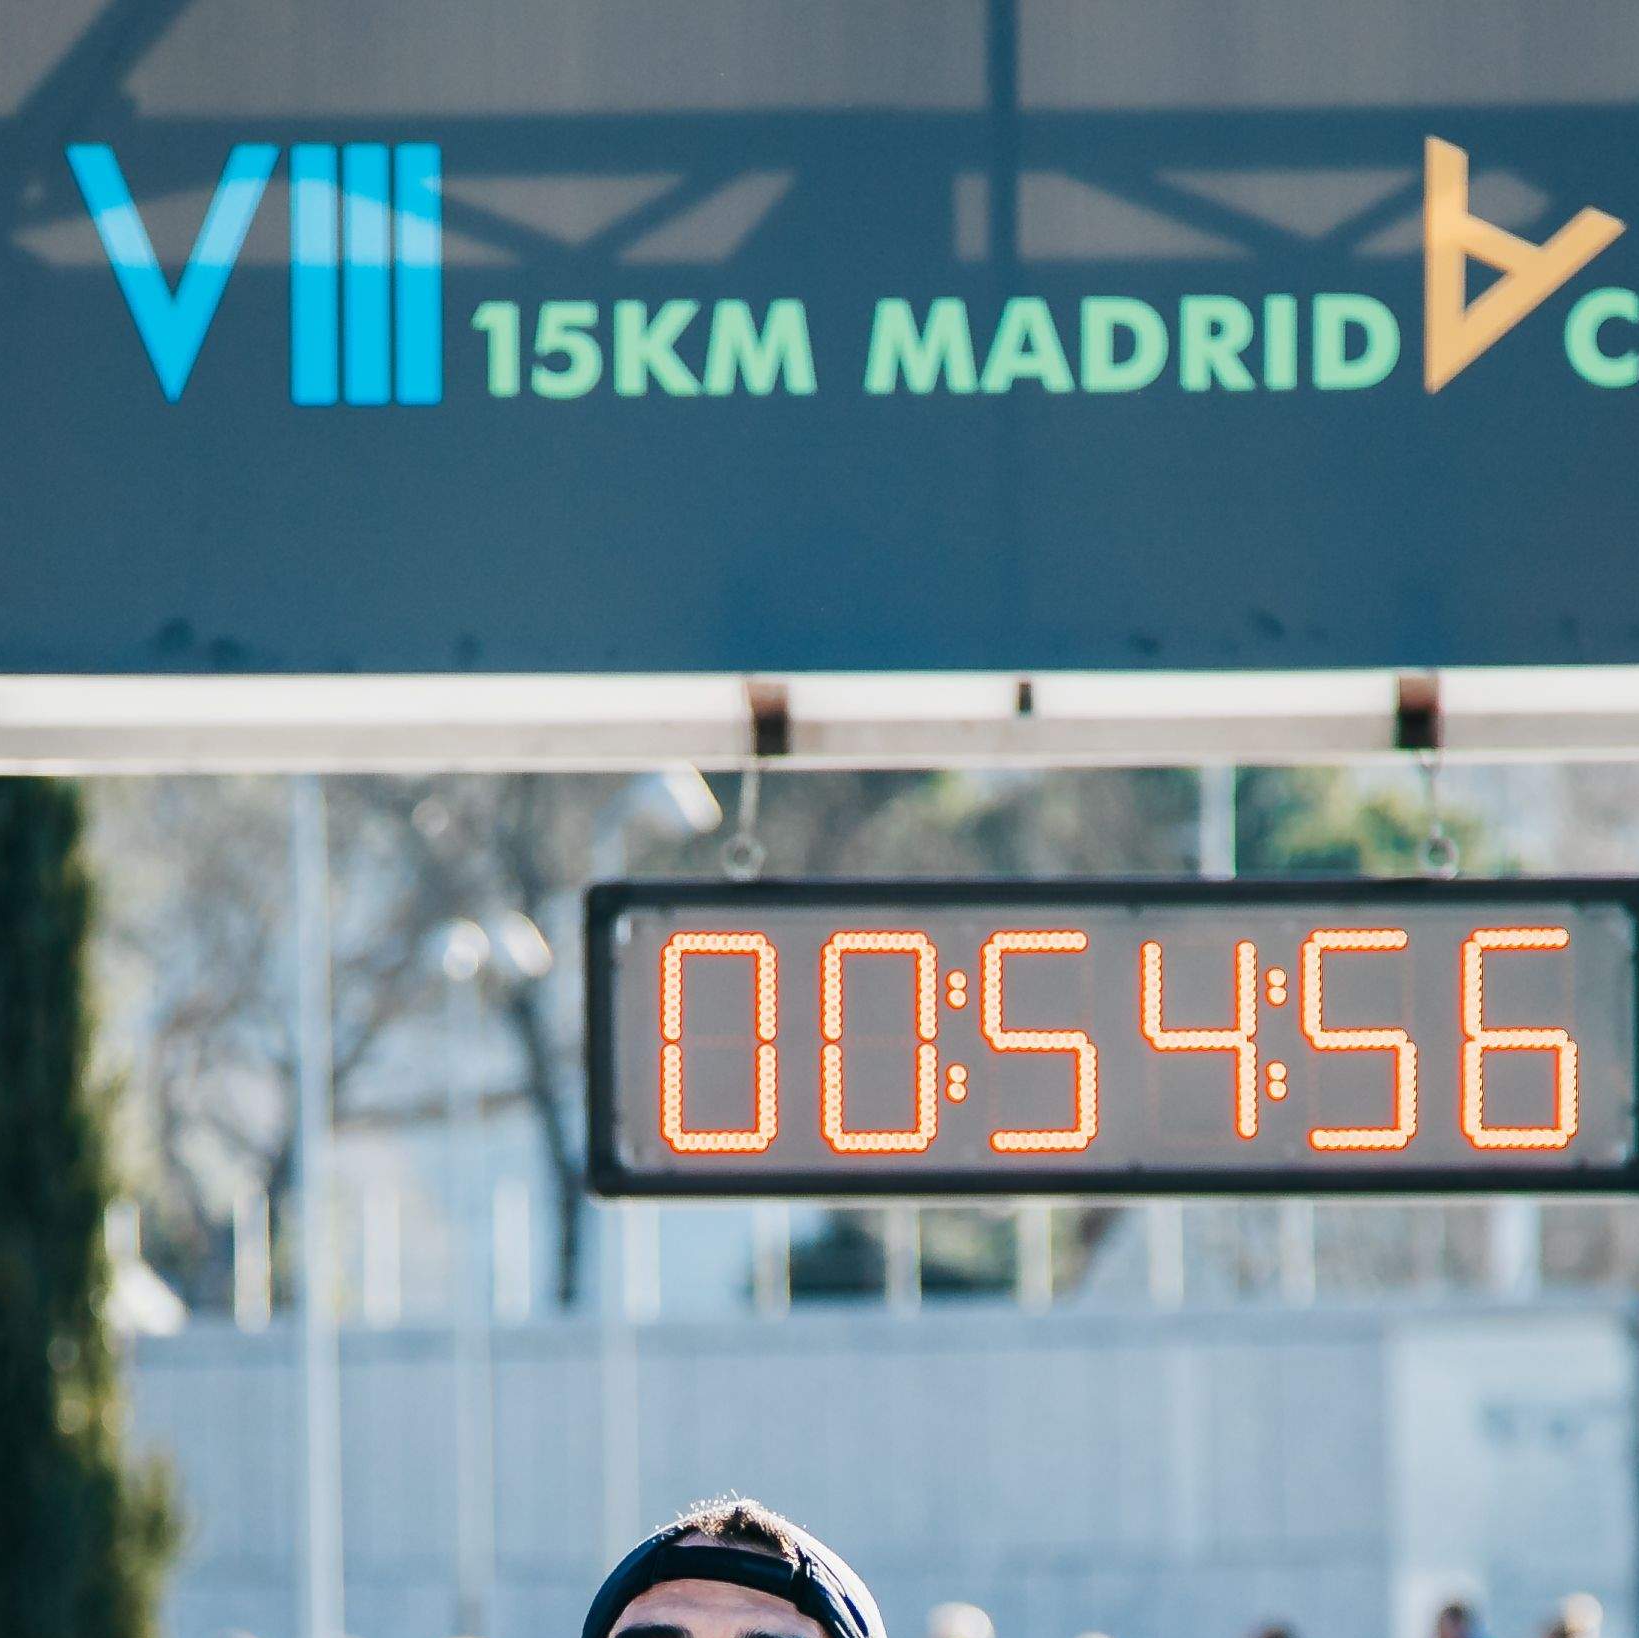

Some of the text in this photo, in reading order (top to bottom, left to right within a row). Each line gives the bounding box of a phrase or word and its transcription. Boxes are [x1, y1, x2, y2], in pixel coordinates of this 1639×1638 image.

[66, 142, 443, 407] VIII
[470, 298, 818, 399] 15KM
[865, 292, 1403, 396] MADRID
[660, 928, 1579, 1154] 00:54:56
